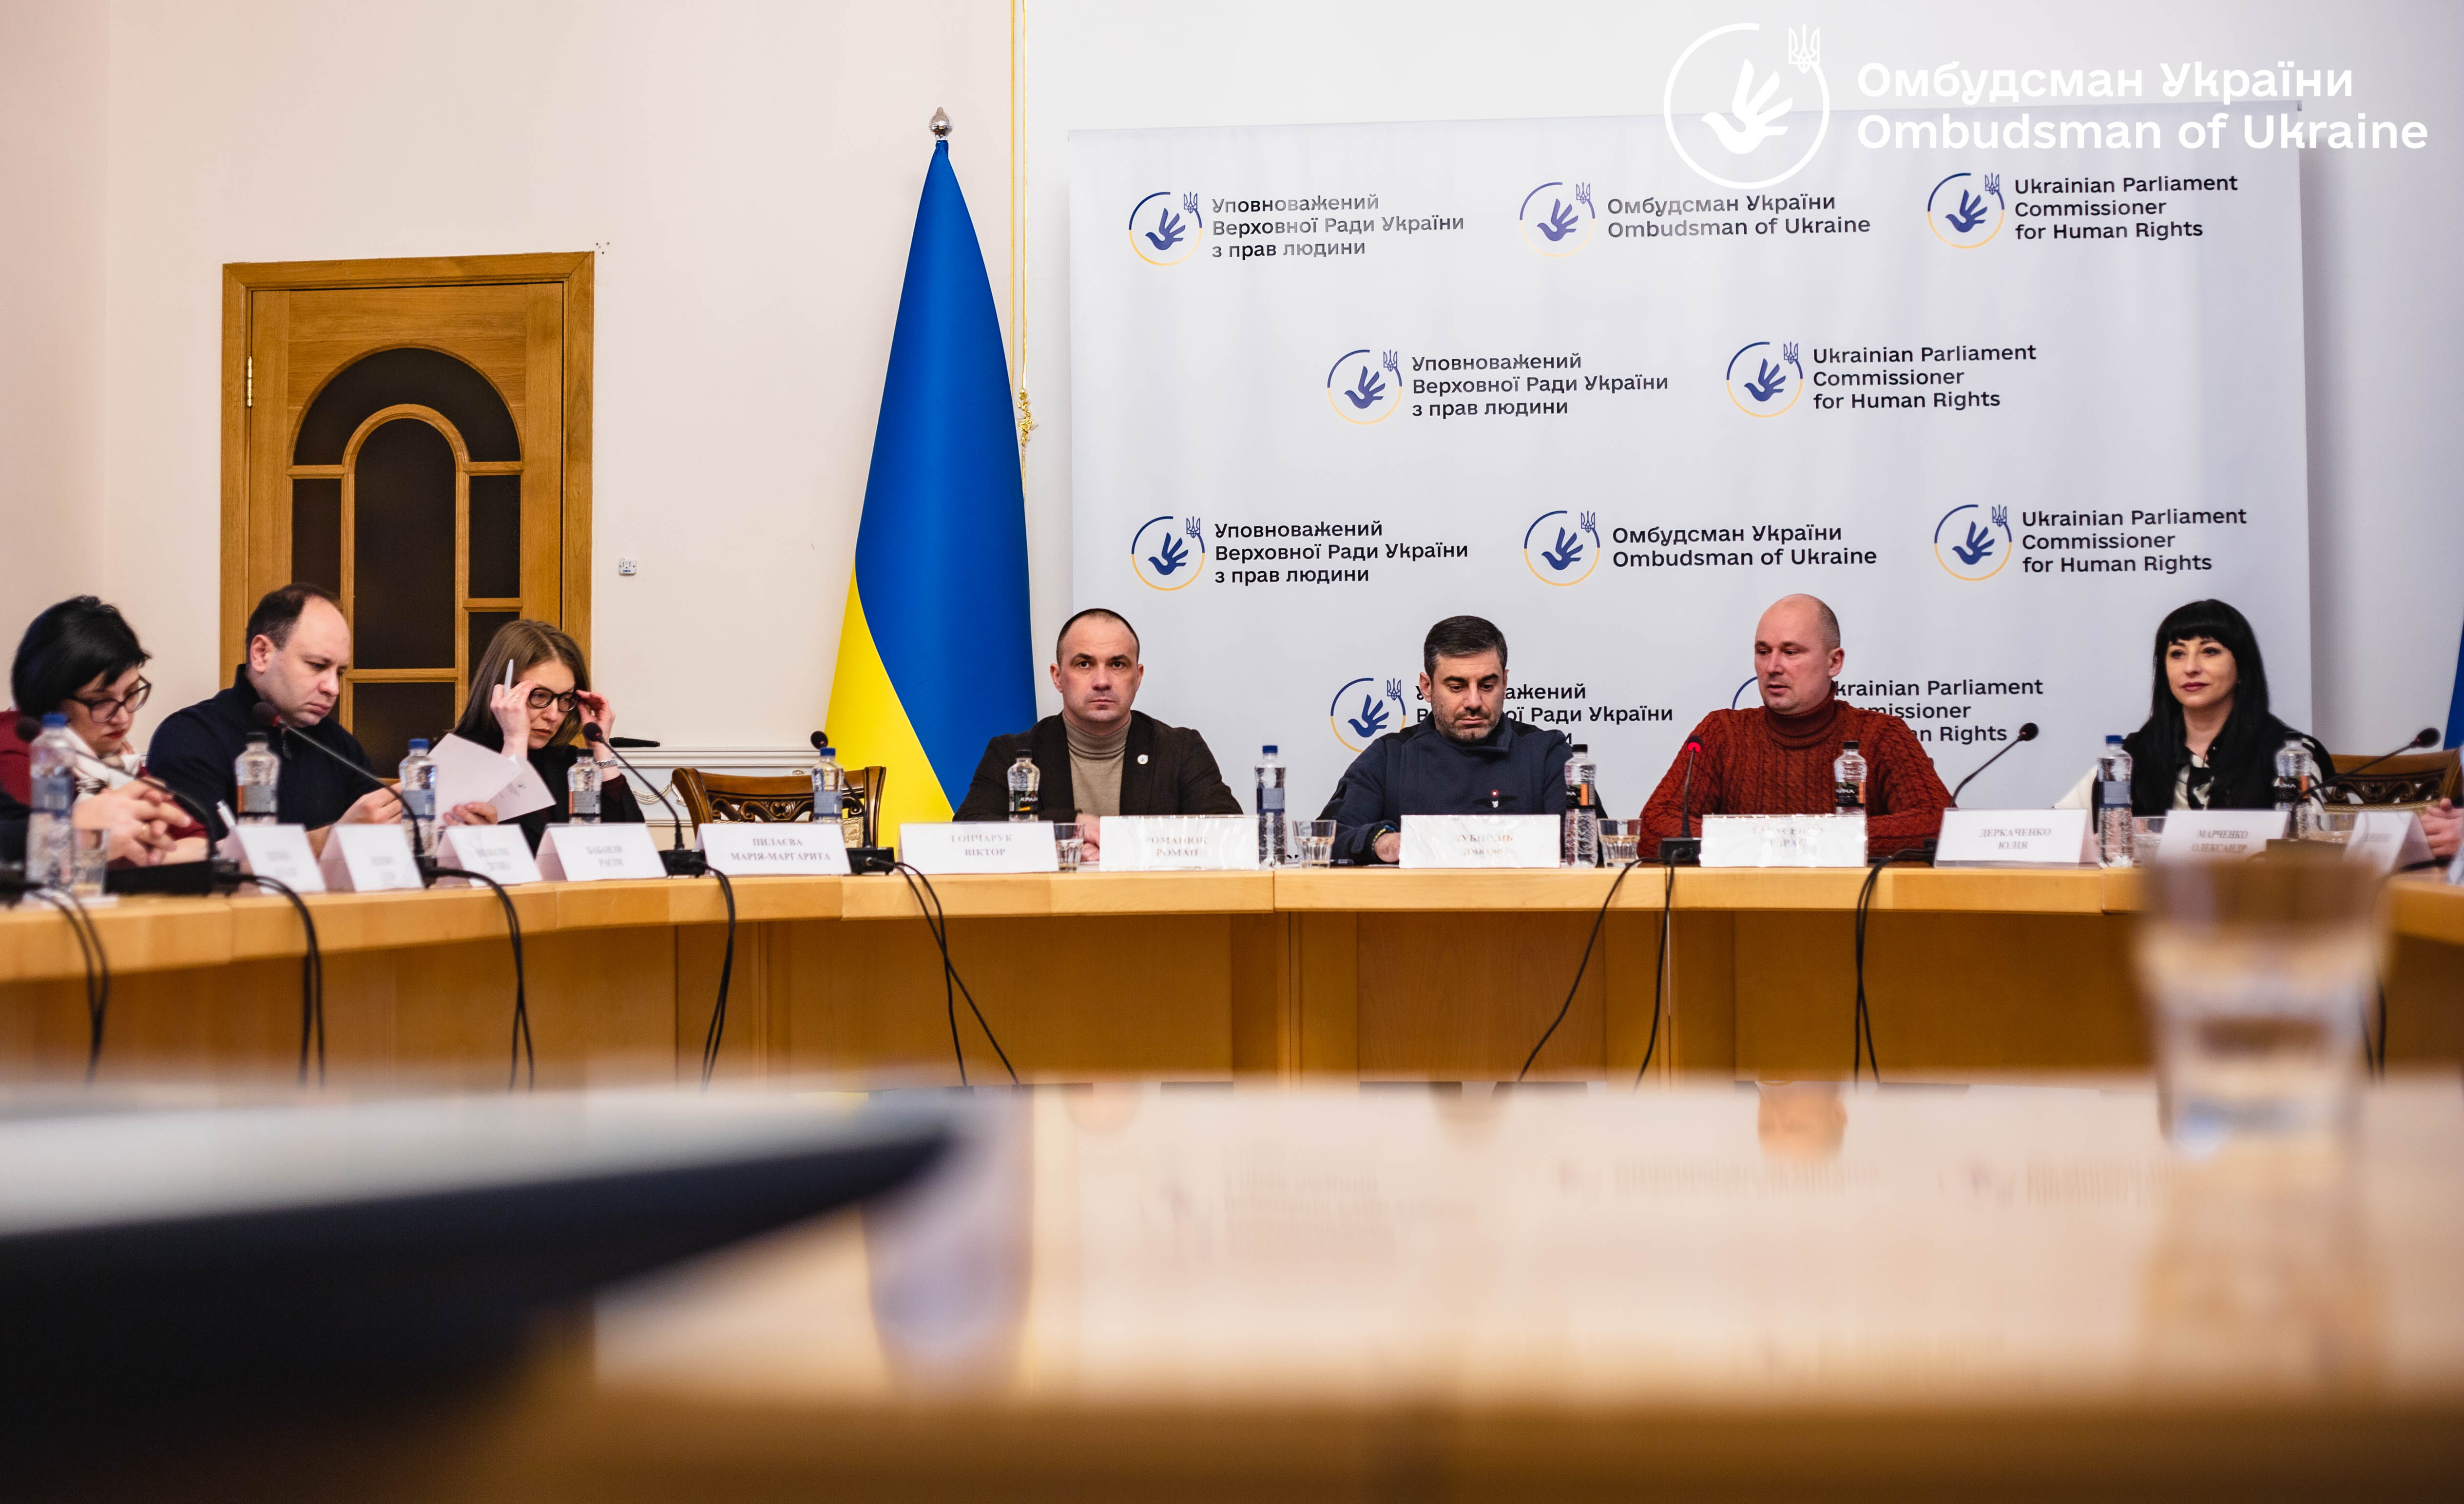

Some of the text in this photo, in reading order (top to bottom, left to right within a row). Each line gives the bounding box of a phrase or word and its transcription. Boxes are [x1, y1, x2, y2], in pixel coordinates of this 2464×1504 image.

[2015, 175, 2238, 194] Ukrainian Parliament
[1212, 194, 1378, 213] Уповноважений
[1608, 193, 1835, 217] Омбудсман України
[2015, 200, 2167, 217] Commissioner
[1213, 215, 1463, 238] Верховної Ради України
[1608, 216, 1870, 238] Ombudsman of Ukraine
[2015, 221, 2203, 241] for Human Rights
[1212, 243, 1365, 261] з прав людини
[1412, 353, 1581, 371] Уповноважений
[1814, 345, 2037, 364] Ukrainian Parliament
[1413, 374, 1668, 397] Верховної Ради України
[1813, 369, 1964, 386] Commissioner
[1813, 391, 2000, 410] for Human Rights
[1412, 402, 1567, 419] з прав людини
[2022, 508, 2247, 526] Ukrainian Parliament
[1214, 521, 1382, 538] Уповноважений
[1613, 524, 1841, 546] Омбудсман України
[2022, 533, 2175, 550] Commissioner
[1216, 542, 1467, 564] Верховної Ради України
[1613, 547, 1877, 567] Ombudsman of Ukraine
[2022, 555, 2212, 575] for Human Rights
[1215, 570, 1368, 586] з прав людини
[1835, 679, 2043, 696] krainian Parliament
[1531, 707, 1582, 724] Ради
[1589, 706, 1673, 725] України
[1940, 725, 2007, 745] Rights
[1979, 828, 2052, 838] ДЕРКАЧЕНКО
[1998, 841, 2028, 850] ЮЛІЯ
